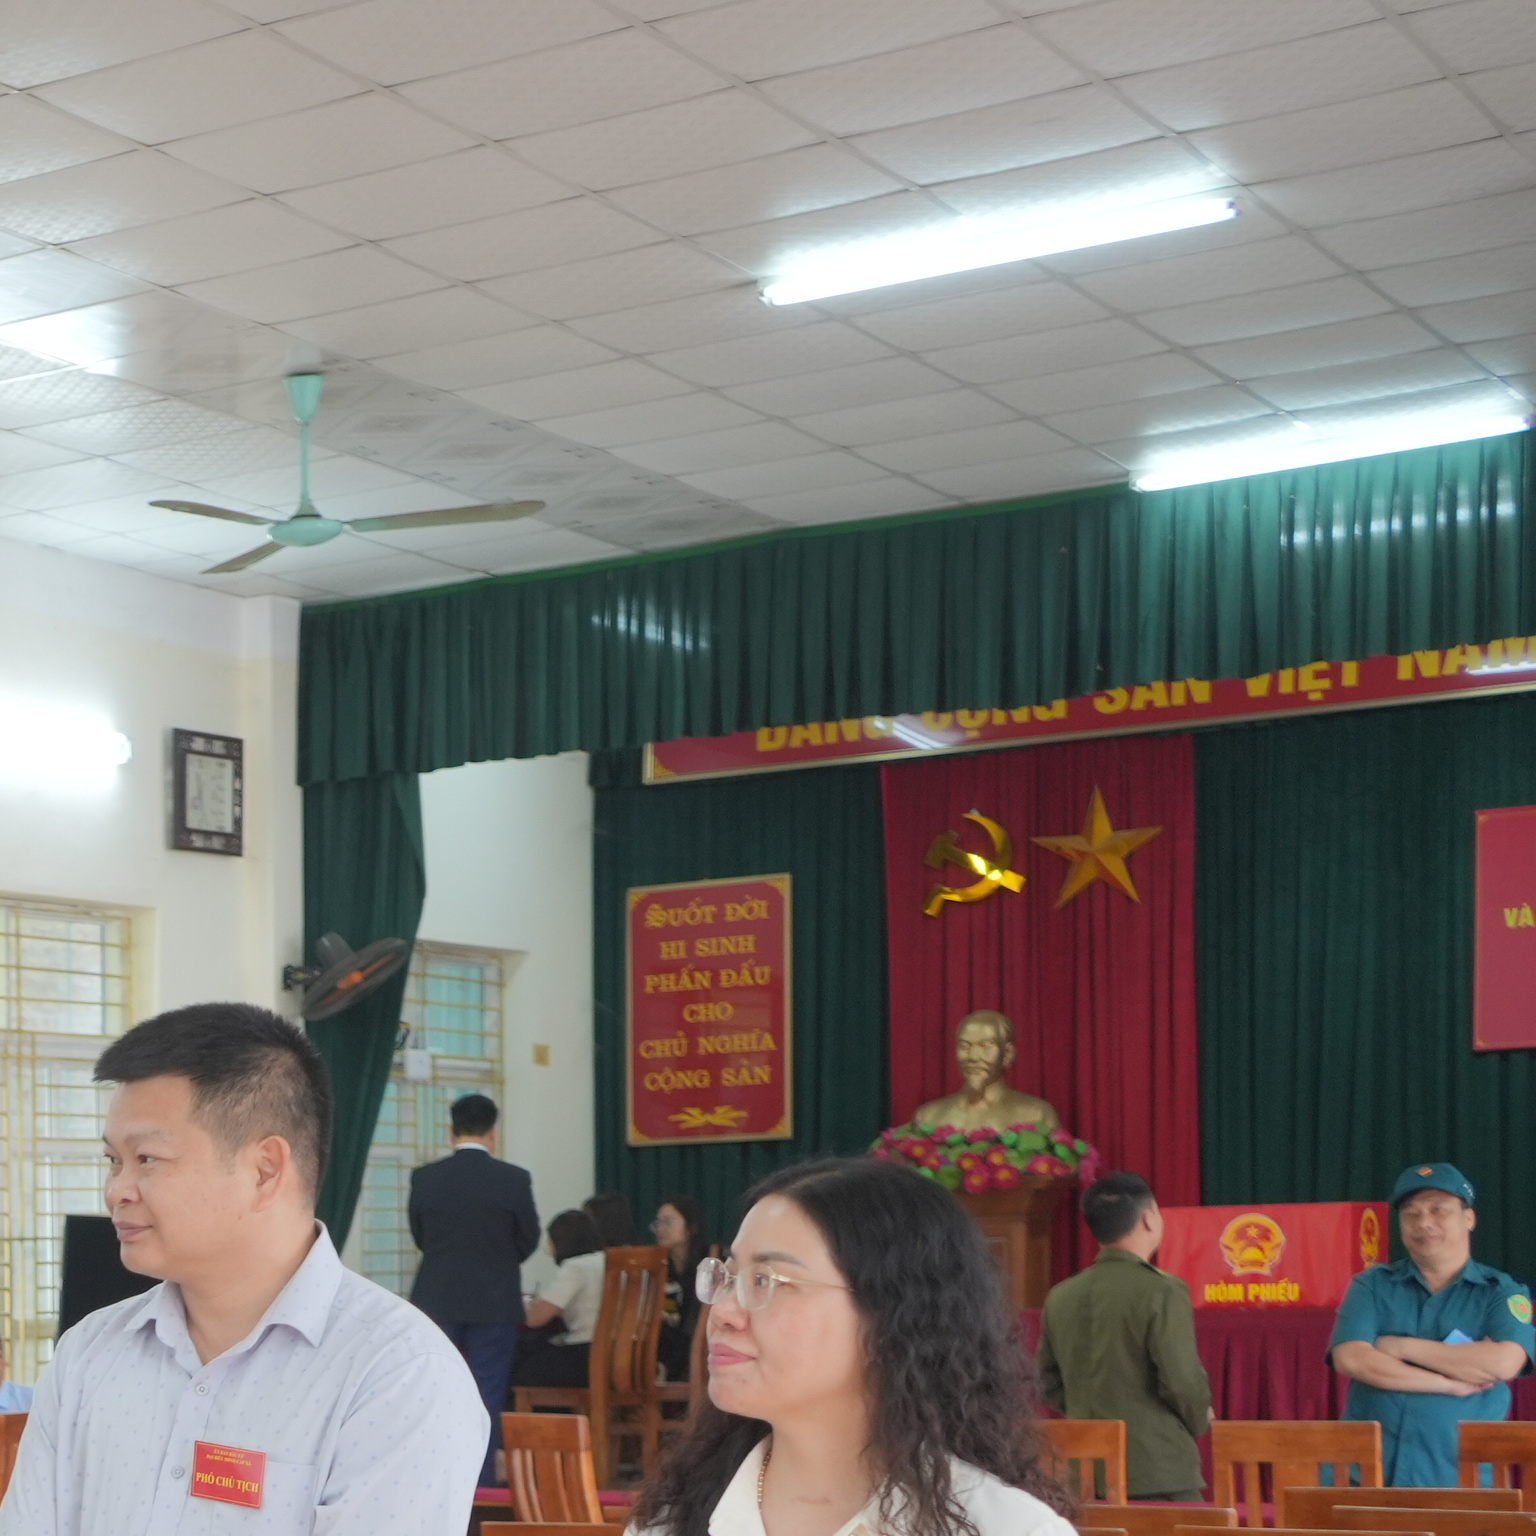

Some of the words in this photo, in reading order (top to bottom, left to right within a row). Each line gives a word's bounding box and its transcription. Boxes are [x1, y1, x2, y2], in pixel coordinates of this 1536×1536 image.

[644, 896, 718, 930] SUỐT
[724, 894, 770, 923] ĐỜI
[659, 939, 688, 961] HI
[694, 934, 757, 958] SINH
[643, 963, 713, 994] PHẤN
[718, 958, 773, 988] ĐẤU
[682, 1001, 736, 1023] CHO
[638, 1029, 689, 1059] CHỦ
[697, 1028, 778, 1056] NGHĨA
[643, 1066, 712, 1095] CỘNG
[720, 1058, 772, 1088] SẢN
[1204, 1279, 1245, 1303] HÒM
[1248, 1277, 1300, 1303] PHIẾU
[196, 1471, 215, 1485] PHÓ
[216, 1476, 235, 1488] CHỦ
[236, 1479, 259, 1493] TỊCH
